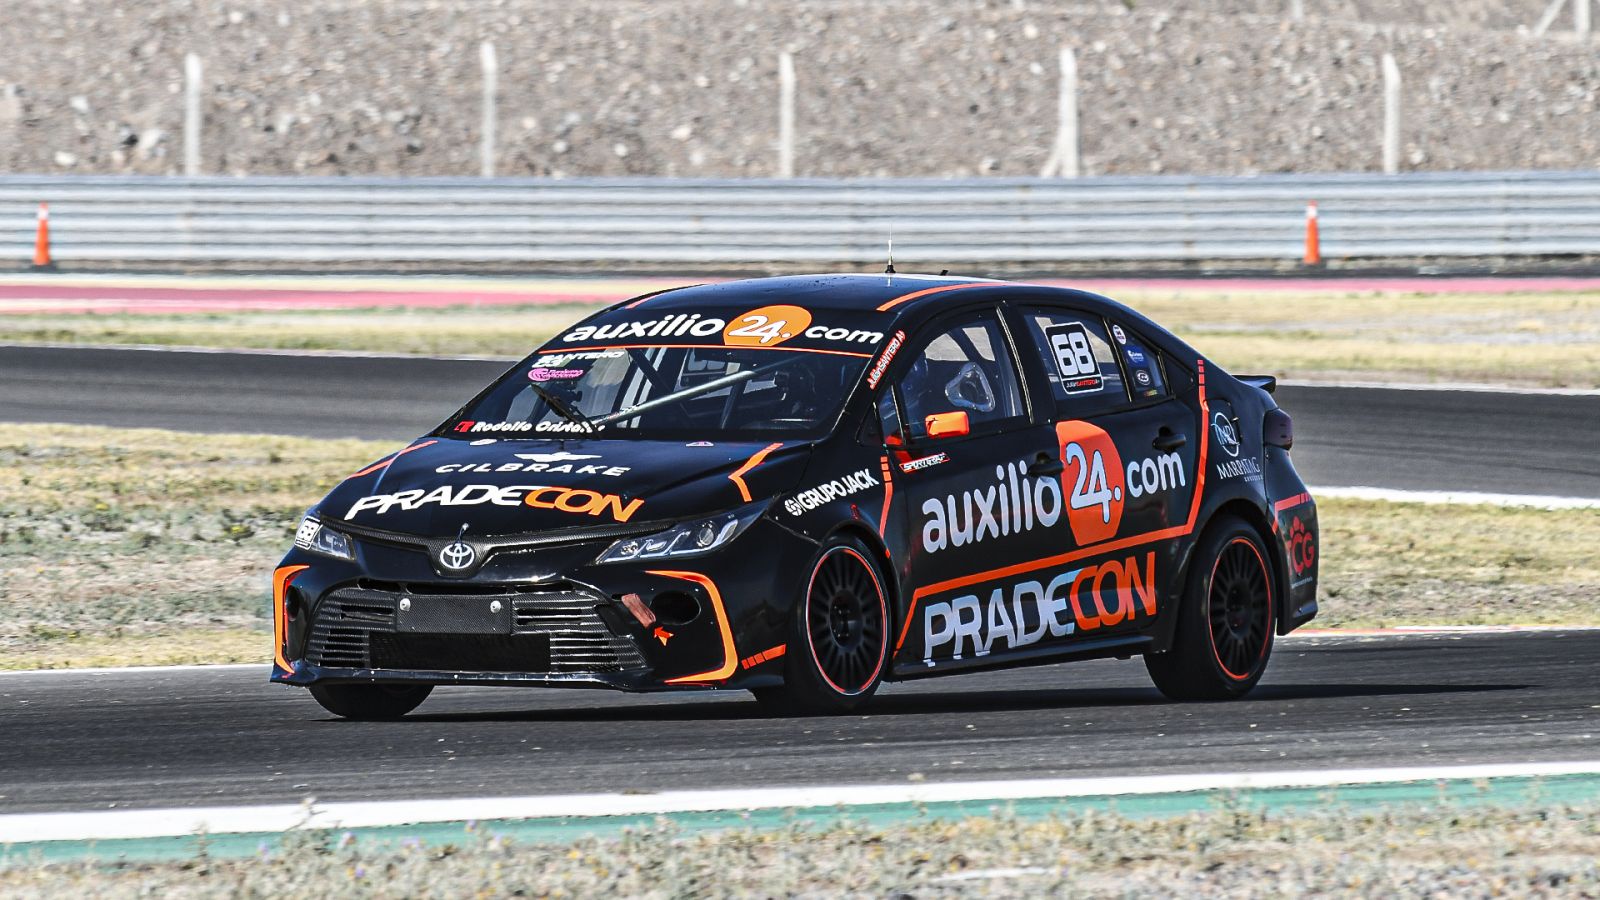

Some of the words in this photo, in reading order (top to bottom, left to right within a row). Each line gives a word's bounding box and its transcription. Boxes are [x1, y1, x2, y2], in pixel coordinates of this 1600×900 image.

[1051, 332, 1096, 376] 68
[470, 421, 533, 433] Rodolfo
[1216, 457, 1260, 480] MARPATAG
[344, 485, 645, 523] PRADECON
[923, 551, 1158, 668] PRADECON
